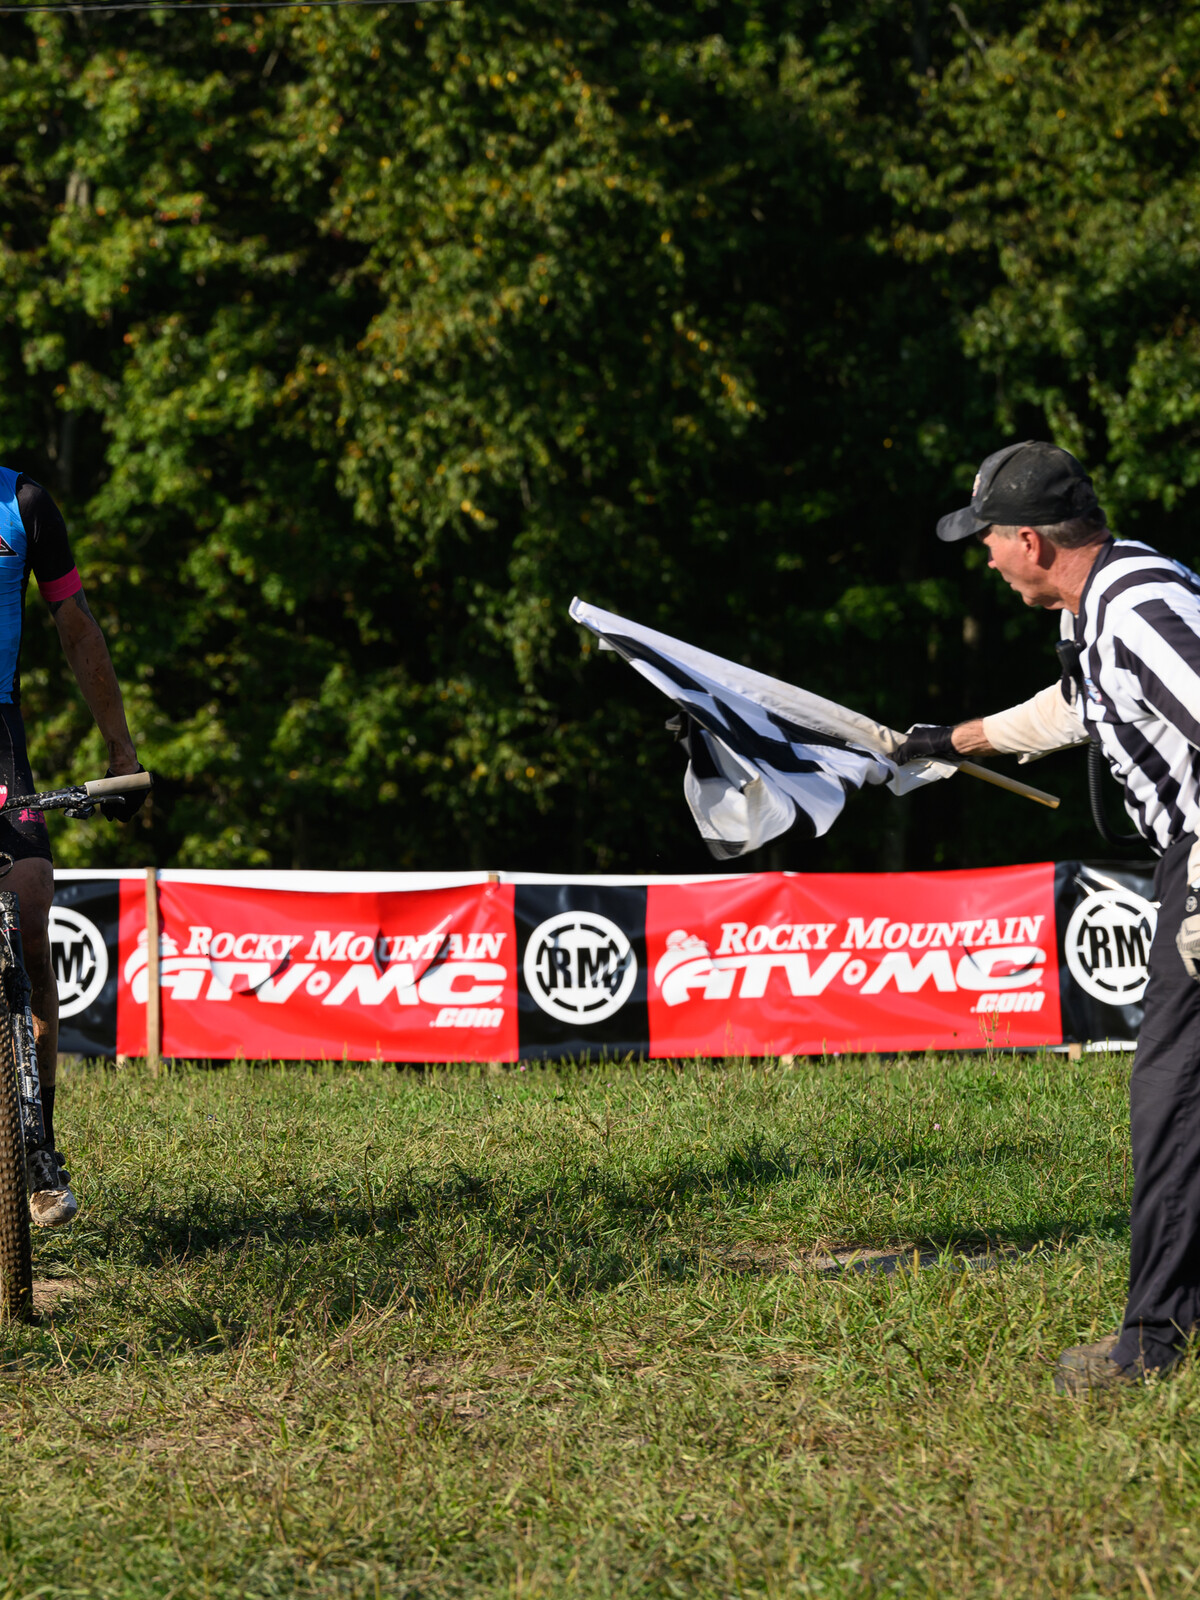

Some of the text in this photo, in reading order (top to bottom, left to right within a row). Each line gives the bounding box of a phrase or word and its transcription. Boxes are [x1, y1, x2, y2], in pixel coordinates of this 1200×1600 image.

[184, 926, 507, 962] ROCKY MOUNTAIN
[715, 915, 1045, 954] ROCKY MOUNTAIN
[1089, 925, 1150, 968] RM
[547, 947, 614, 988] RM
